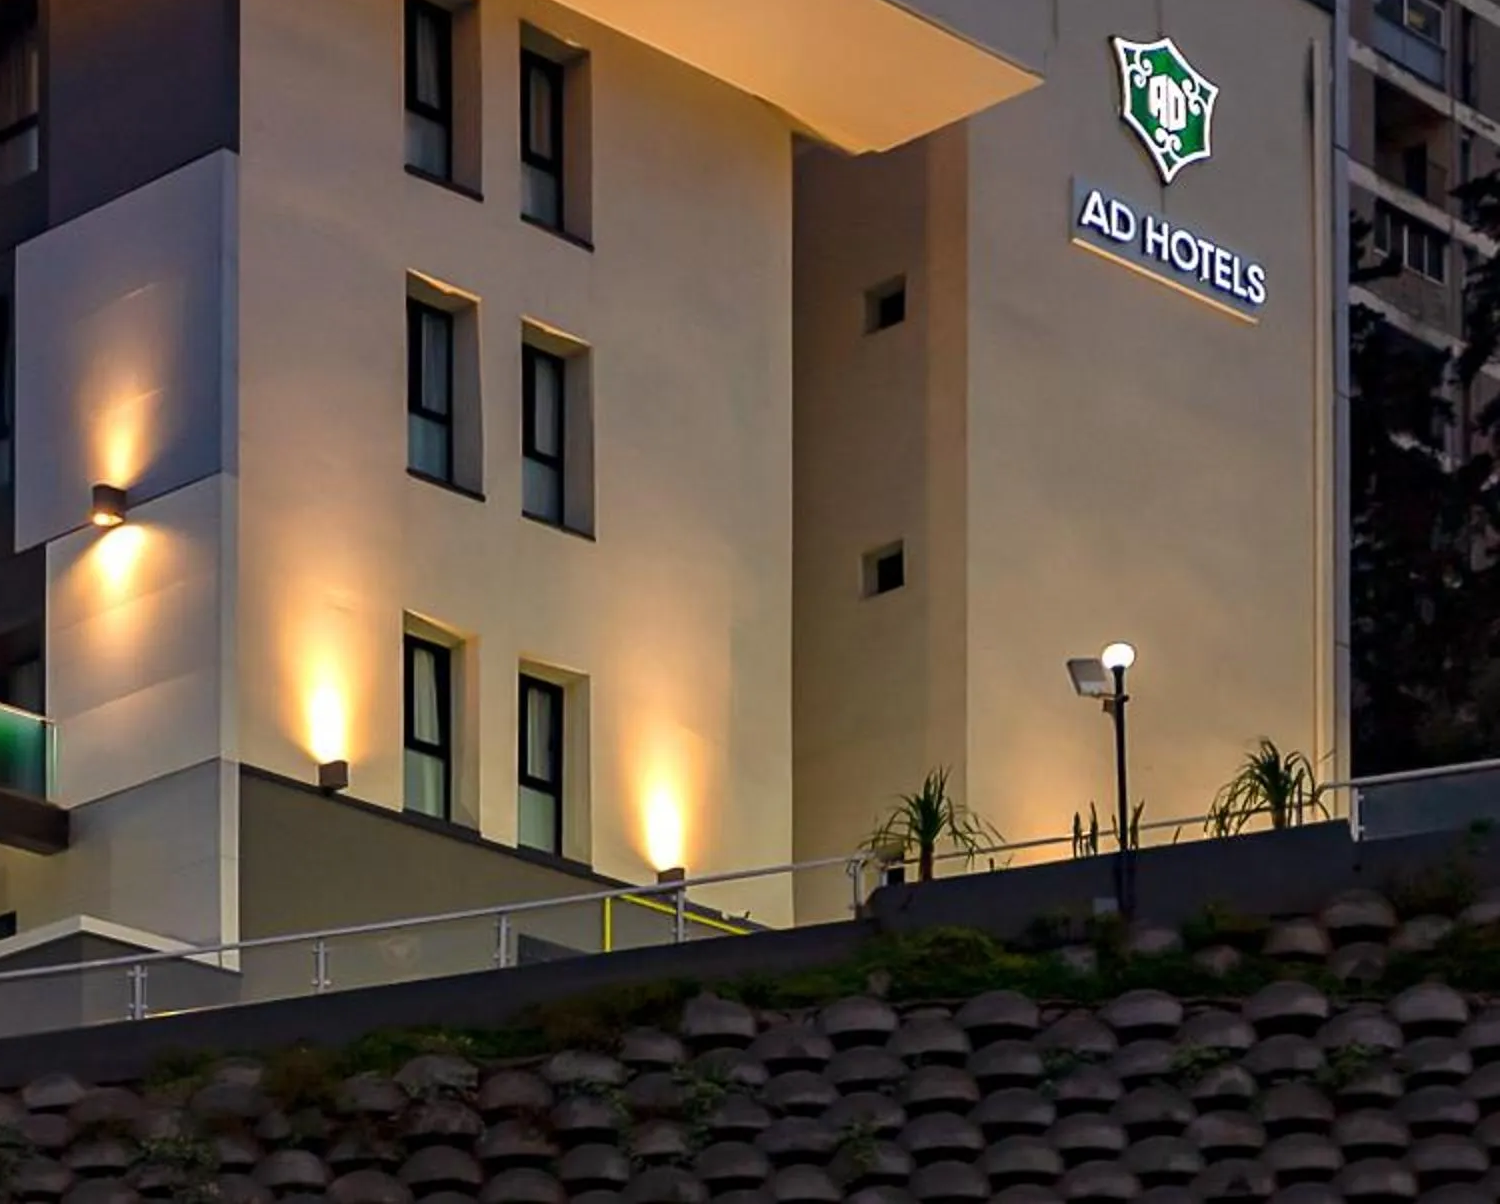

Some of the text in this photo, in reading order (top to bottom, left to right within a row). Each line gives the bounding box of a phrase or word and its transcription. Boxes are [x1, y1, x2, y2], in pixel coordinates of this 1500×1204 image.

[1148, 73, 1187, 132] AD
[1081, 190, 1266, 304] AD HOTELS
